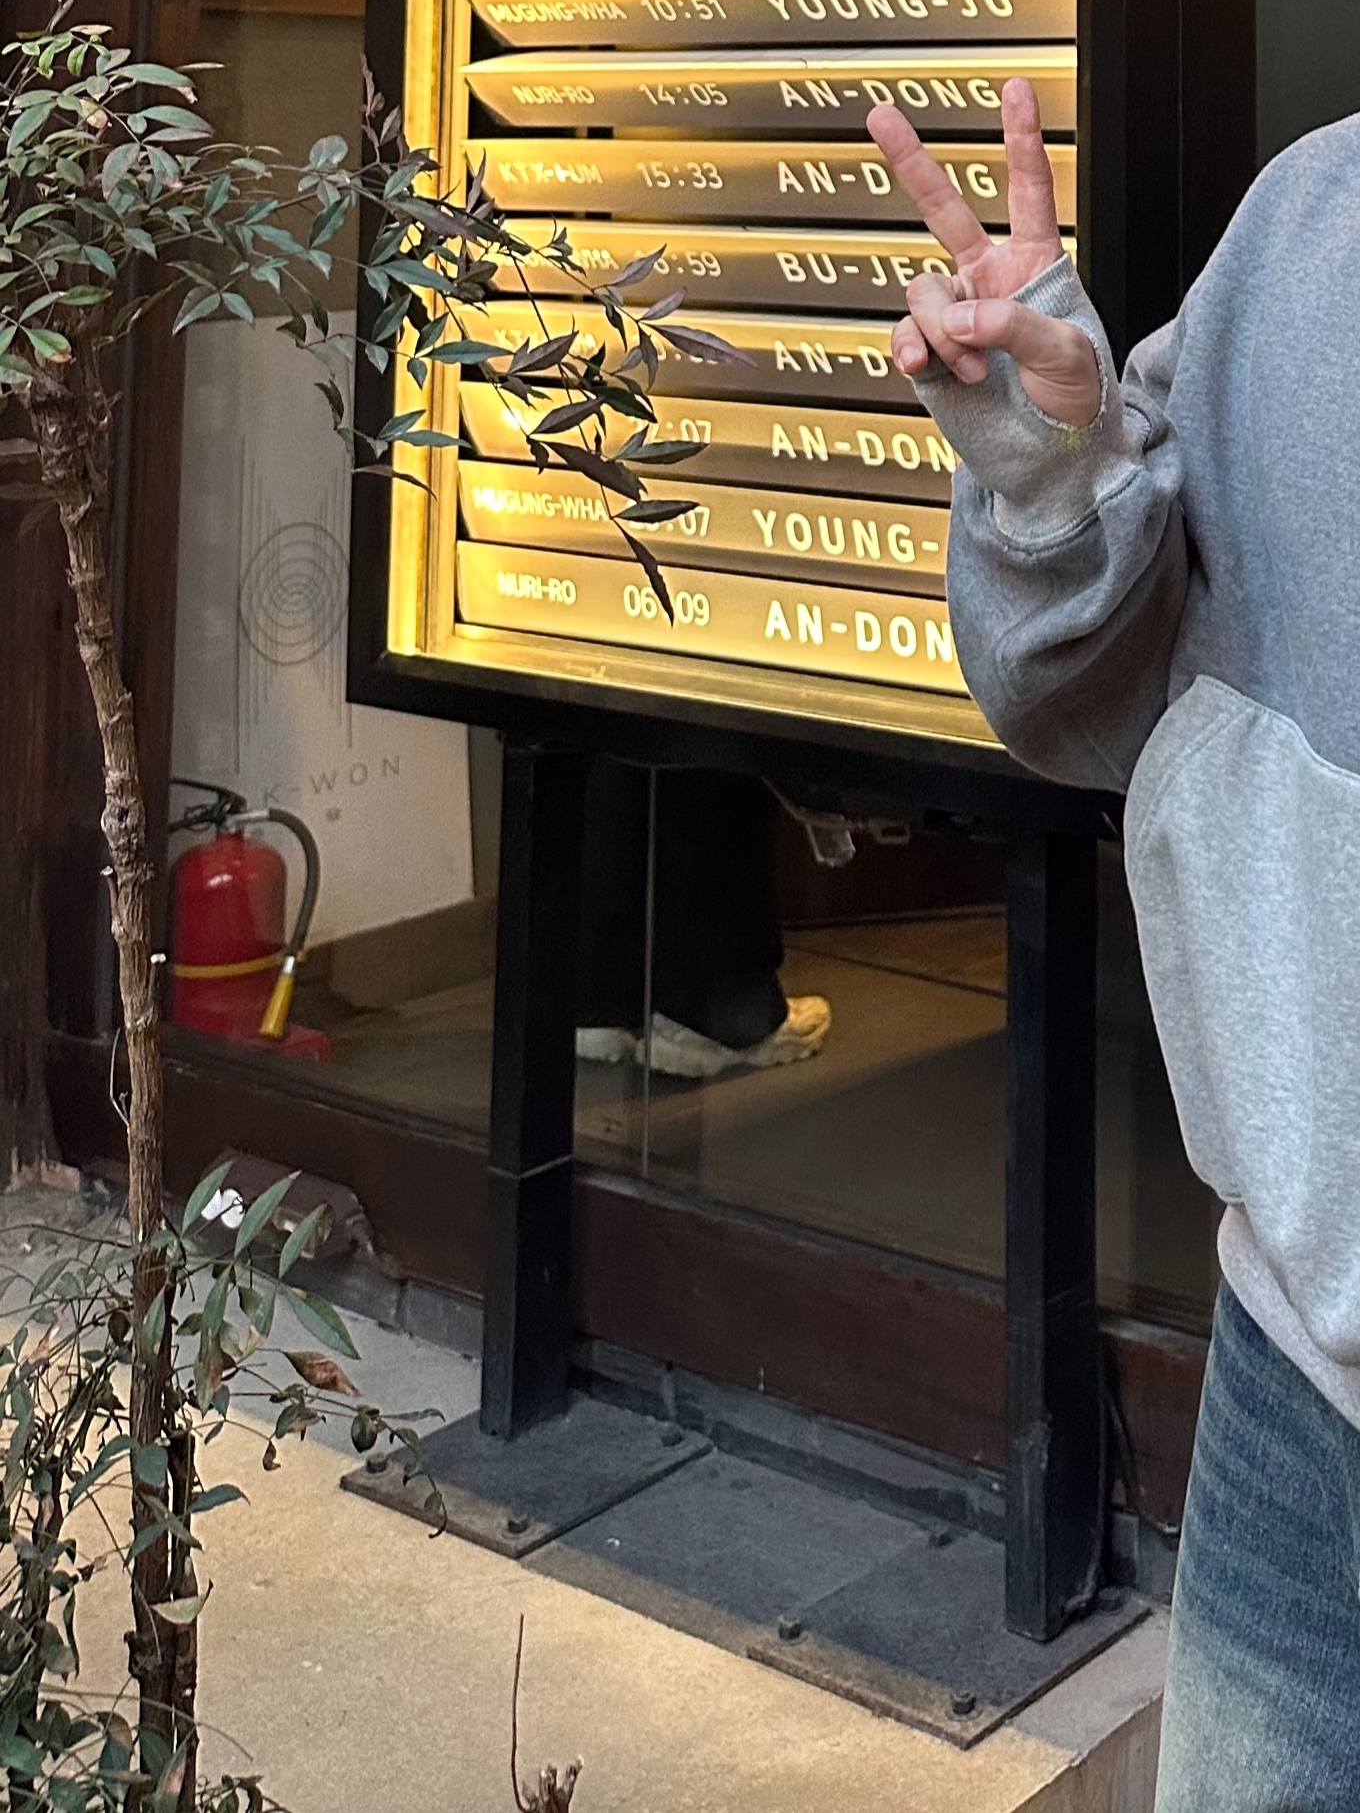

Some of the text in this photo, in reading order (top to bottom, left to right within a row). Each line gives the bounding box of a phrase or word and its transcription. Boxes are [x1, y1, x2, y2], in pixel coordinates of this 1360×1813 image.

[487, 1, 627, 24] MUGUNG-WHA
[512, 78, 1002, 108] NURI-RO 14:05 AN-DONG
[637, 161, 724, 190] 15:33
[777, 160, 999, 199] AN-DG
[774, 251, 952, 287] BU-JEO
[773, 340, 890, 378] AN-D
[771, 423, 957, 474] AN-DON
[471, 485, 610, 522] MUGUNG-WHA
[751, 508, 940, 564] YOUNG-
[497, 571, 954, 664] NURI-RO 0609 AN-DON
